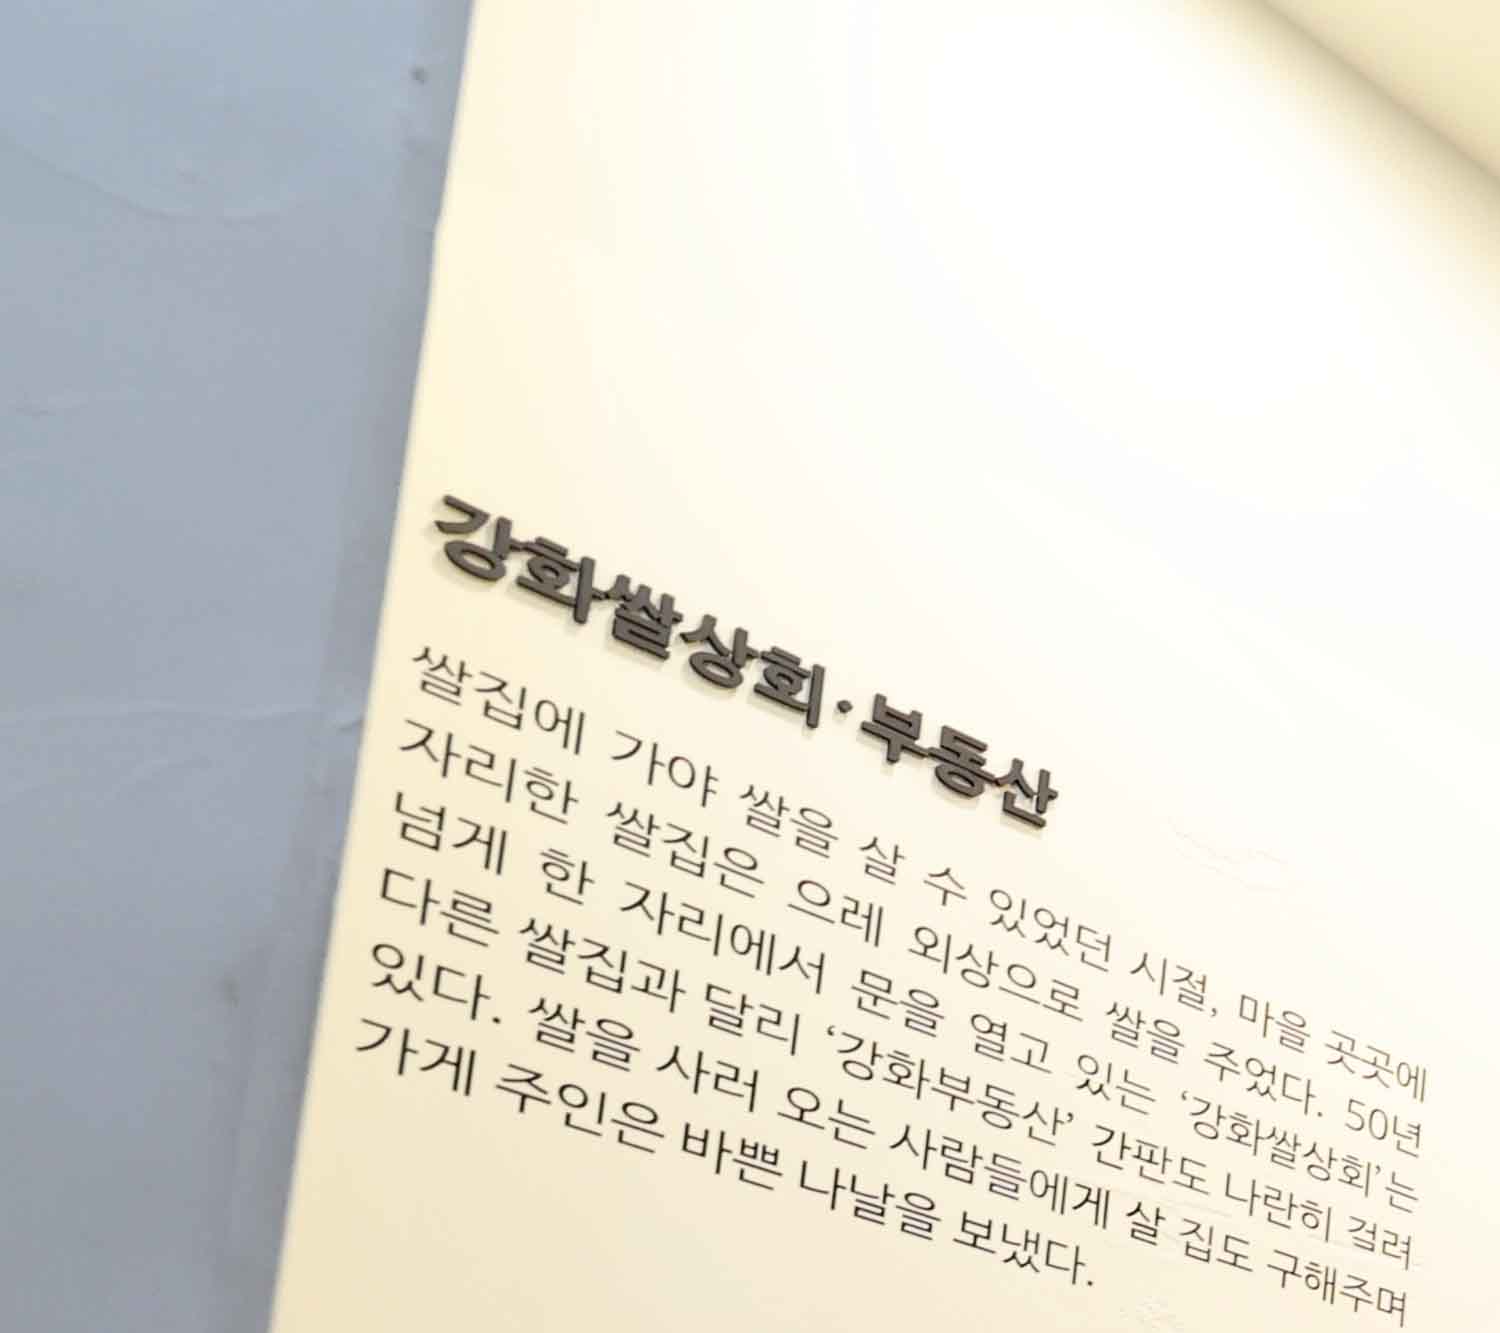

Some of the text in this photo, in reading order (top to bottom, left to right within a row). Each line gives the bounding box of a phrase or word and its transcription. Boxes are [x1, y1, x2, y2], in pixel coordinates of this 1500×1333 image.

[378, 866, 1413, 1272] 다른 쌀집과 달리 ‘강화부동산’ 간판도 나란히 걸려
[393, 789, 1420, 1214] 넘게 한 자리에서 문을 열고 있는 ‘강화쌀상회’는
[397, 718, 1422, 1159] 자리한 쌀집은 으레 외상으로 쌀을 주었다. 50년
[411, 645, 1428, 1104] 쌀집에 가야 쌀을 살 수 있었던 시절, 마을 곳곳에
[354, 1017, 1095, 1288] 가게 주인은 바쁜 나날을 보냈다.
[370, 942, 1408, 1329] 있다. 쌀을 사러 오는 사람들에게 살 집도 구해주며
